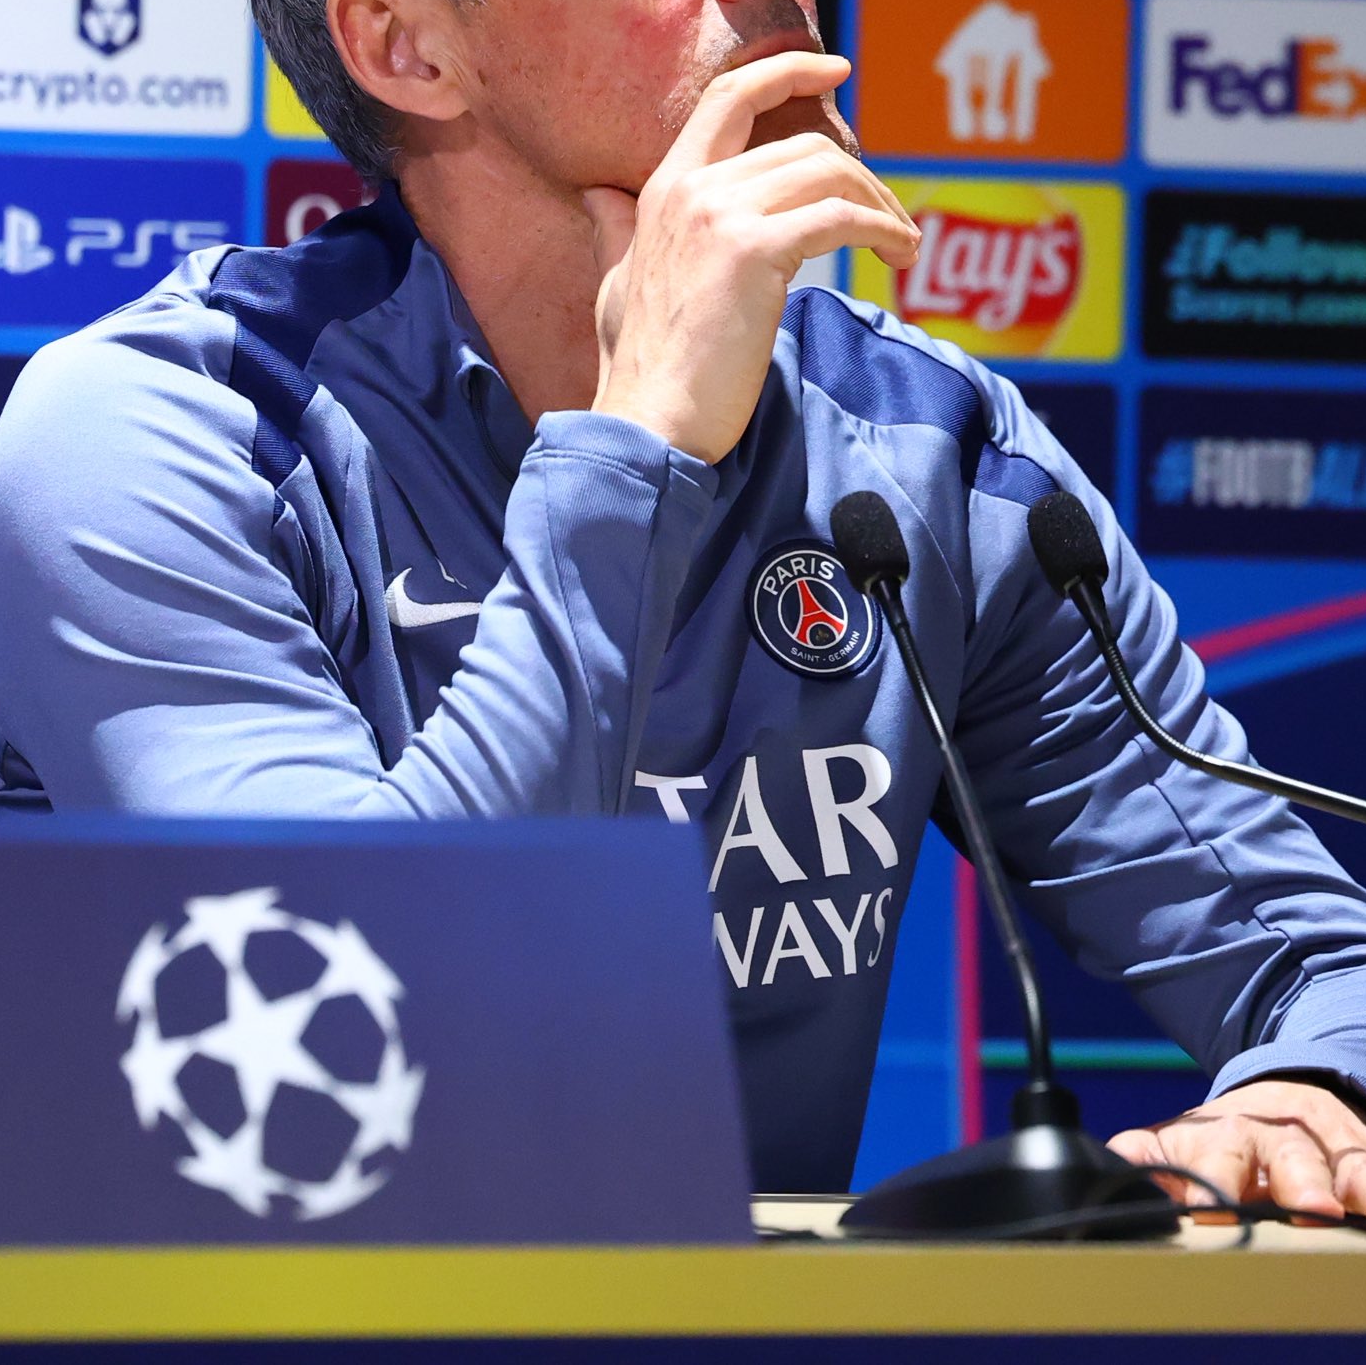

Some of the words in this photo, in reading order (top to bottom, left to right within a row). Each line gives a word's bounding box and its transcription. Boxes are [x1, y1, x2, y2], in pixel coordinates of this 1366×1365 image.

[67, 216, 229, 267] PS5
[902, 212, 1069, 331] Lay's
[762, 557, 835, 595] PARIS
[635, 743, 899, 893] TAR
